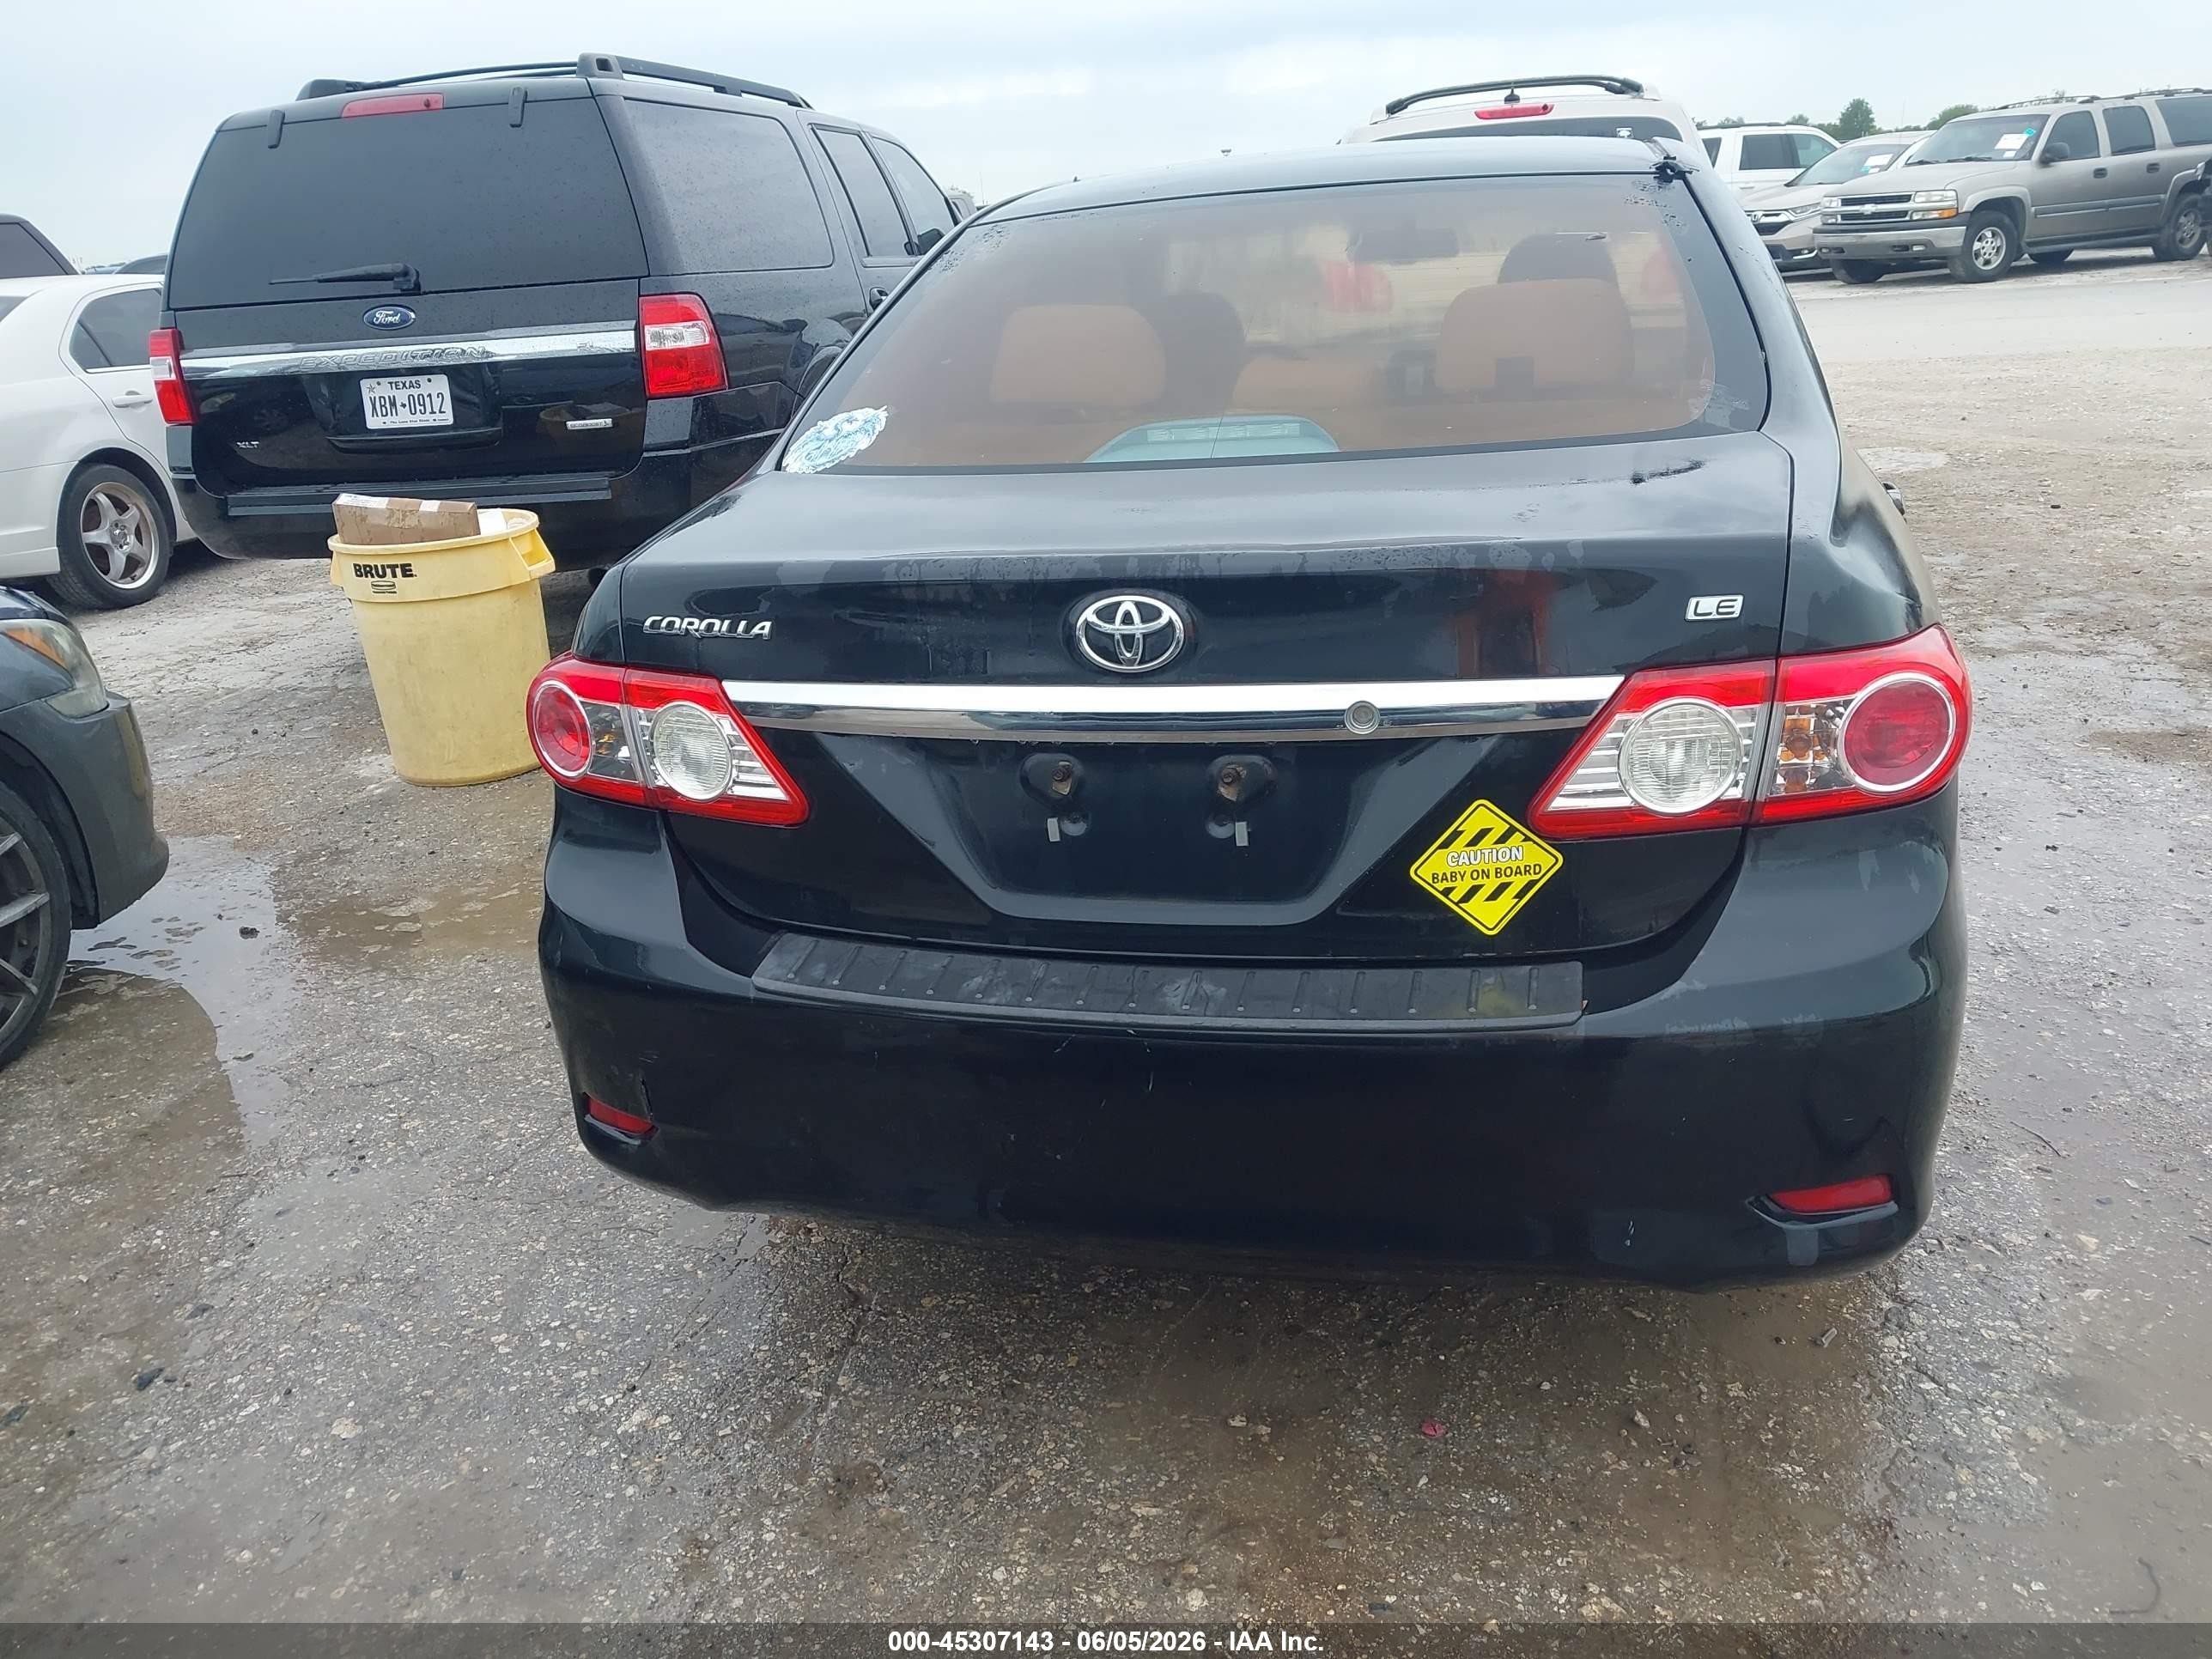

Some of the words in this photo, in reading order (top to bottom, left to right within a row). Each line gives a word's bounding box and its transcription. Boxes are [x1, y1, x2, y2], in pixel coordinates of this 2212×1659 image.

[374, 310, 400, 324] Ford
[301, 346, 486, 368] EXPEDITION
[387, 380, 422, 390] TEXAS
[1693, 599, 1738, 617] LE
[643, 616, 773, 640] COROLLA
[1446, 845, 1524, 867] CAUTION
[1431, 870, 1467, 884] BABY
[1470, 868, 1491, 881] ON
[1495, 863, 1542, 879] BOARD
